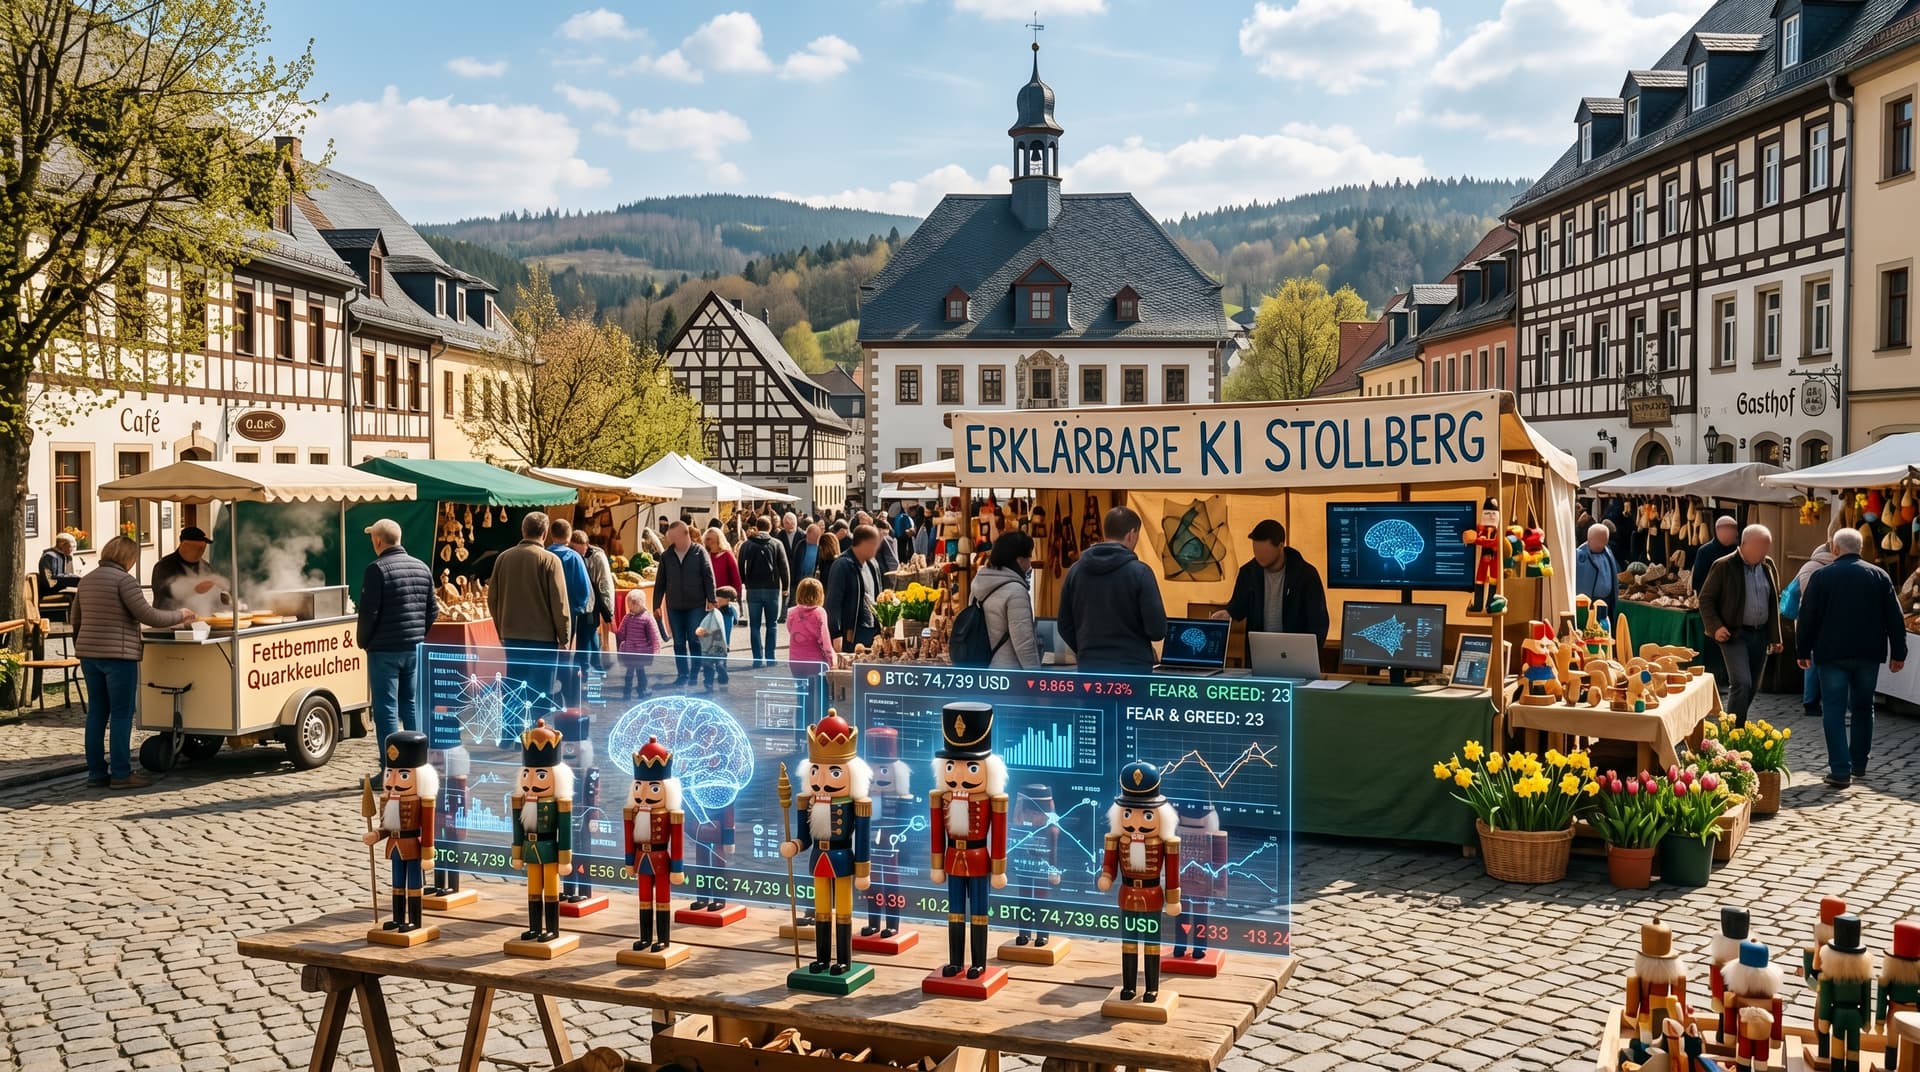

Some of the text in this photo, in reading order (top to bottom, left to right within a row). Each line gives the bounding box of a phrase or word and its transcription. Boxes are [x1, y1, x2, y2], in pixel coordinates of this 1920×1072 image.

[1736, 387, 1796, 419] Gasthof
[120, 407, 161, 437] Café
[966, 411, 1486, 475] ERKLÄRBARE KI STOLLBERG
[252, 630, 353, 664] Fettbemme &
[247, 656, 360, 690] Quarkkeulchen
[885, 672, 919, 686] BTC:
[922, 673, 974, 689] 74,739
[978, 674, 1010, 691] USD
[1094, 682, 1132, 696] 3.73%
[1206, 685, 1266, 702] GREED:
[1271, 688, 1290, 703] 23
[1126, 706, 1264, 727] FEAR & GREED: 23
[462, 851, 506, 867] 74,739
[696, 875, 728, 892] BTC:
[732, 878, 781, 896] 74,739
[785, 885, 815, 900] USD
[999, 904, 1036, 923] BTC:
[1039, 908, 1120, 930] 74,739.65
[1124, 916, 1159, 934] USD
[1196, 923, 1229, 941] 233
